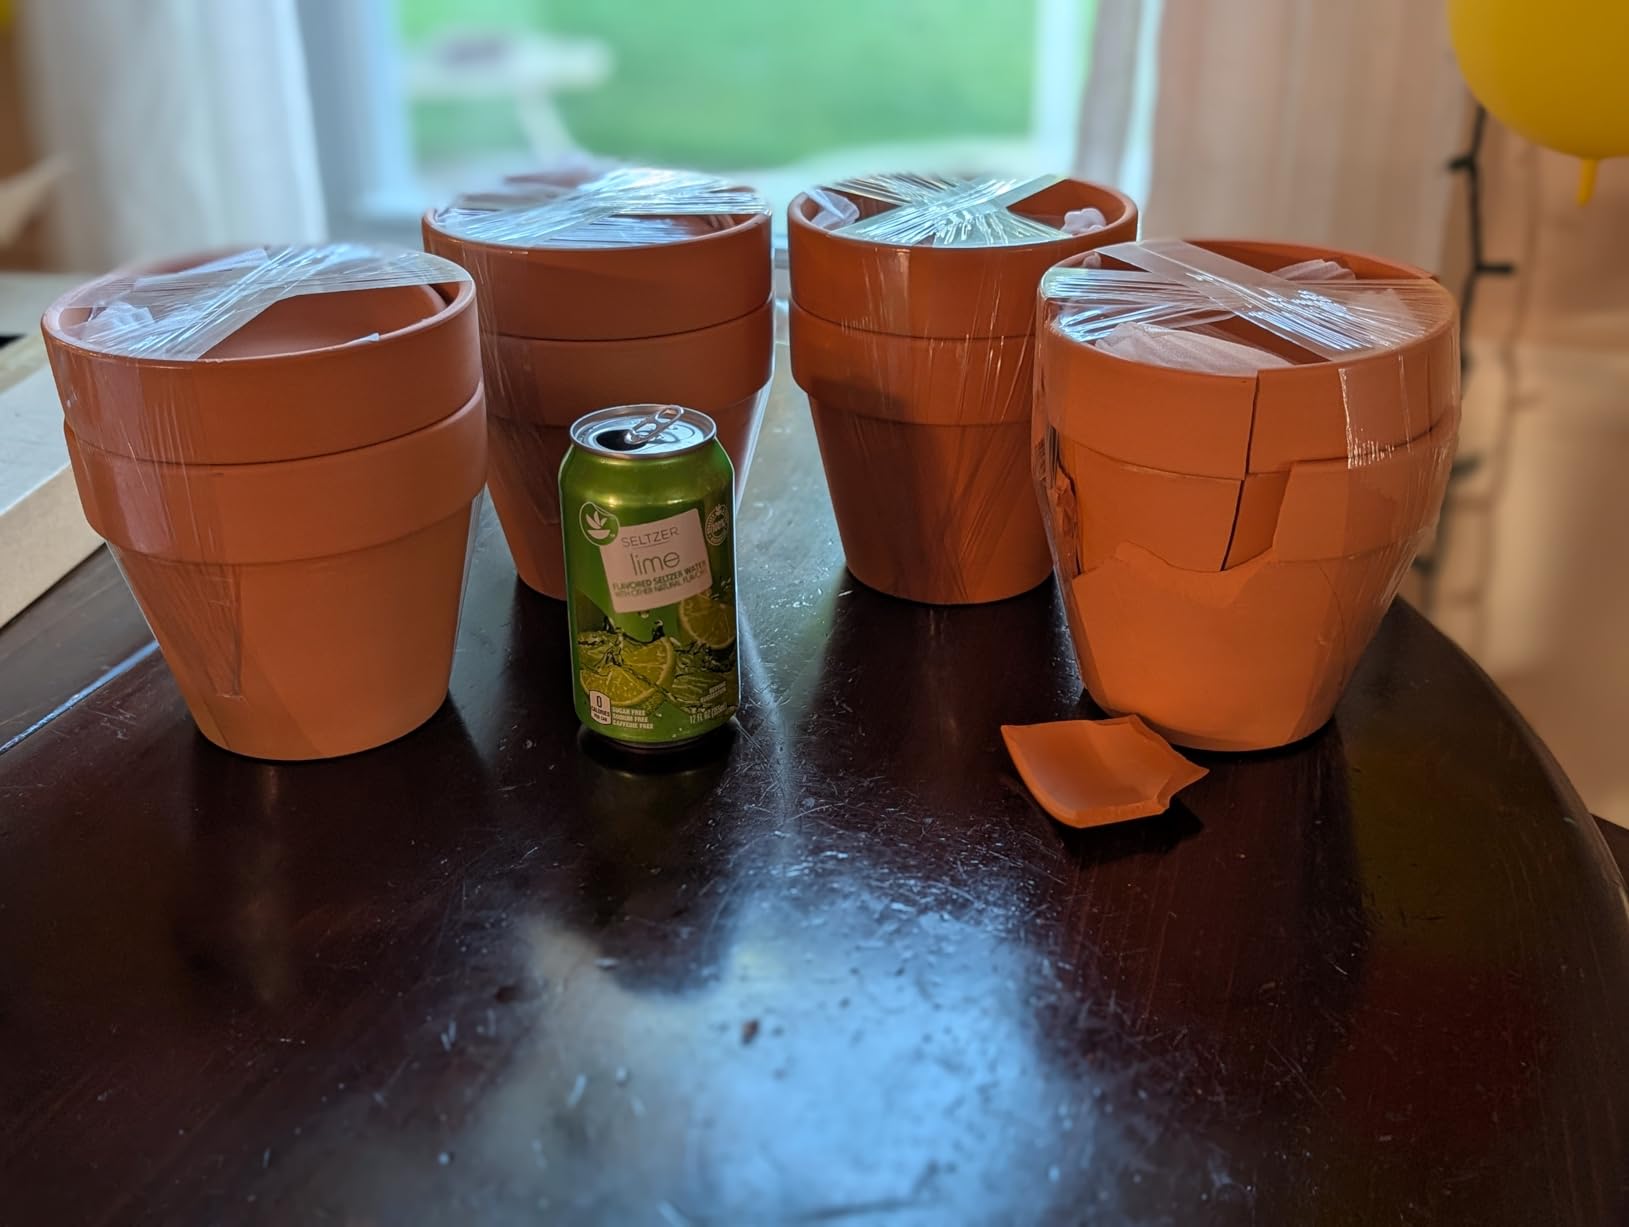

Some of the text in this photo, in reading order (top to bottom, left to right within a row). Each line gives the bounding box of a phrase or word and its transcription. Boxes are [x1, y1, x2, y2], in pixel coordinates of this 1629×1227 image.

[621, 526, 680, 547] SELTZER
[630, 552, 680, 576] lime
[612, 560, 706, 591] FLAVORED SELTZER WATER
[596, 695, 603, 709] 0
[591, 705, 610, 717] CALORIES
[631, 709, 646, 717] FREE
[690, 714, 696, 724] 12
[639, 722, 654, 730] FREE
